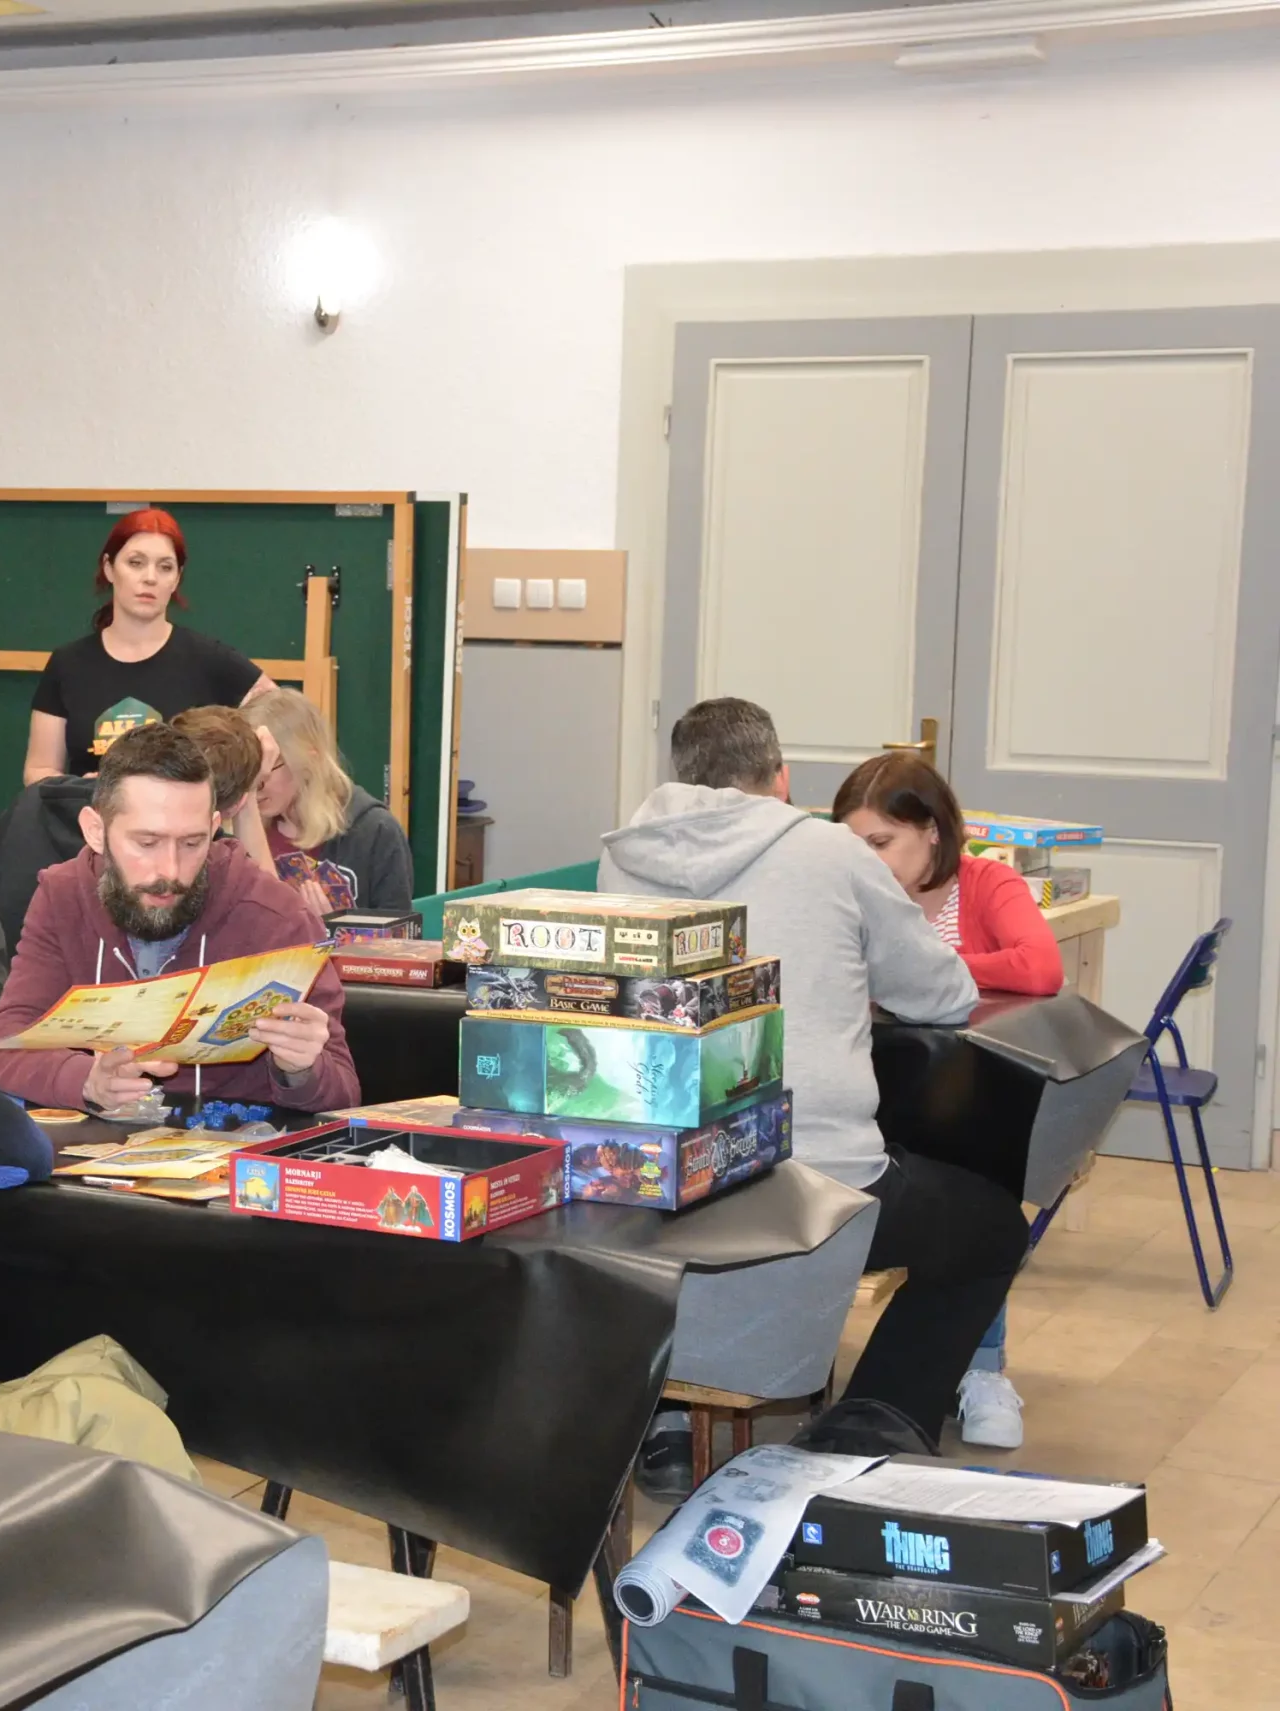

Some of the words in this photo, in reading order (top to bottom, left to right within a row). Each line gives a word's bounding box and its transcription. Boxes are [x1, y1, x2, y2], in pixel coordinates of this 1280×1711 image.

[404, 596, 412, 670] JOOLA
[456, 600, 464, 674] JOOLA
[502, 922, 602, 952] ROOT
[674, 924, 722, 956] ROOT
[550, 998, 577, 1010] BASIC
[580, 1000, 610, 1013] GAME
[285, 1167, 322, 1180] MORNARJI
[444, 1181, 456, 1238] KOSMOS
[881, 1528, 950, 1571] THING
[855, 1598, 904, 1622] WAR
[923, 1608, 977, 1635] RING
[886, 1621, 901, 1630] THE
[902, 1622, 925, 1632] CARD
[926, 1625, 952, 1636] GAME
